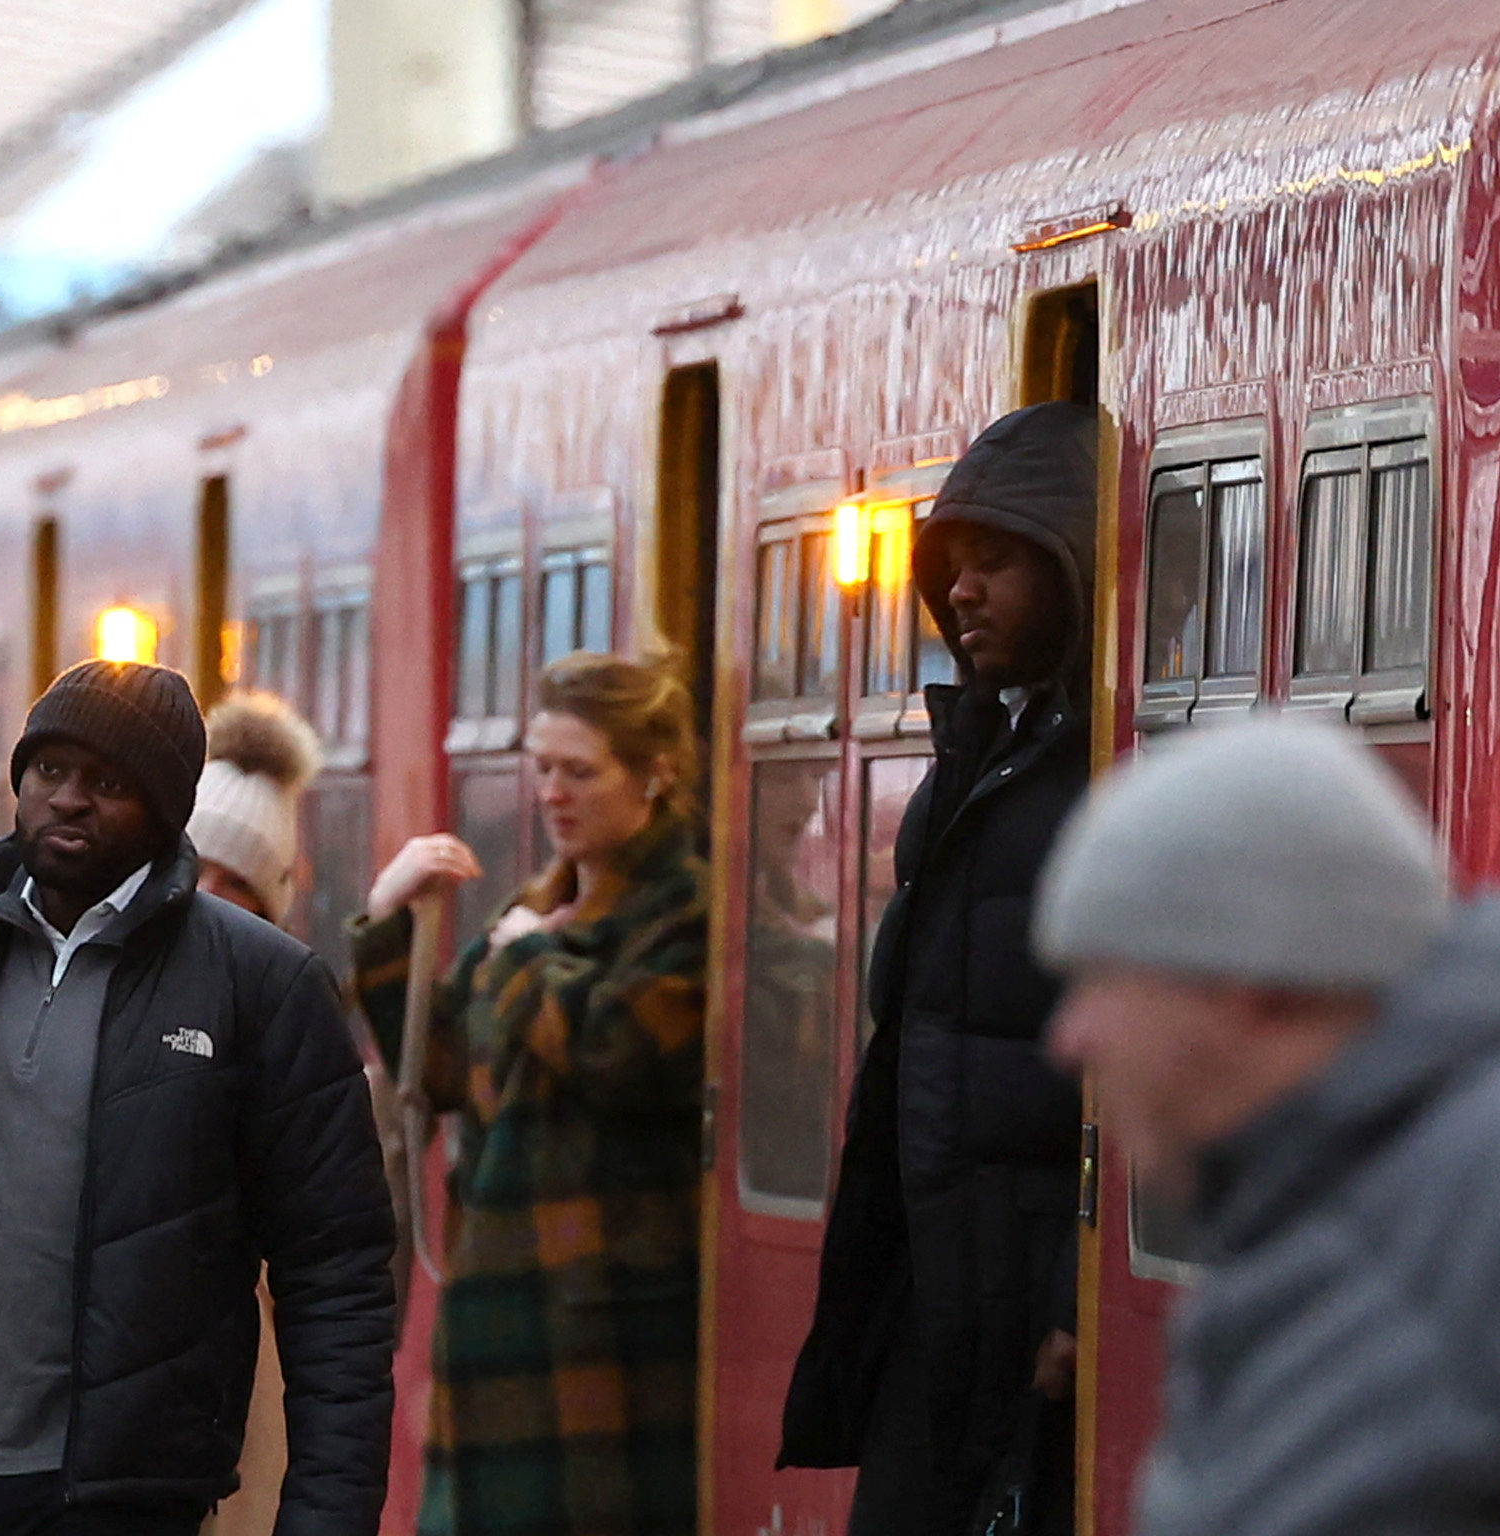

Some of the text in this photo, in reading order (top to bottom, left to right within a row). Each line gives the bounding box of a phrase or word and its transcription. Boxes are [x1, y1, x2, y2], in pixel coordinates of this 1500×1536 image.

[179, 1027, 197, 1039] THE
[162, 1034, 196, 1047] NORTH
[171, 1042, 195, 1054] FACE
